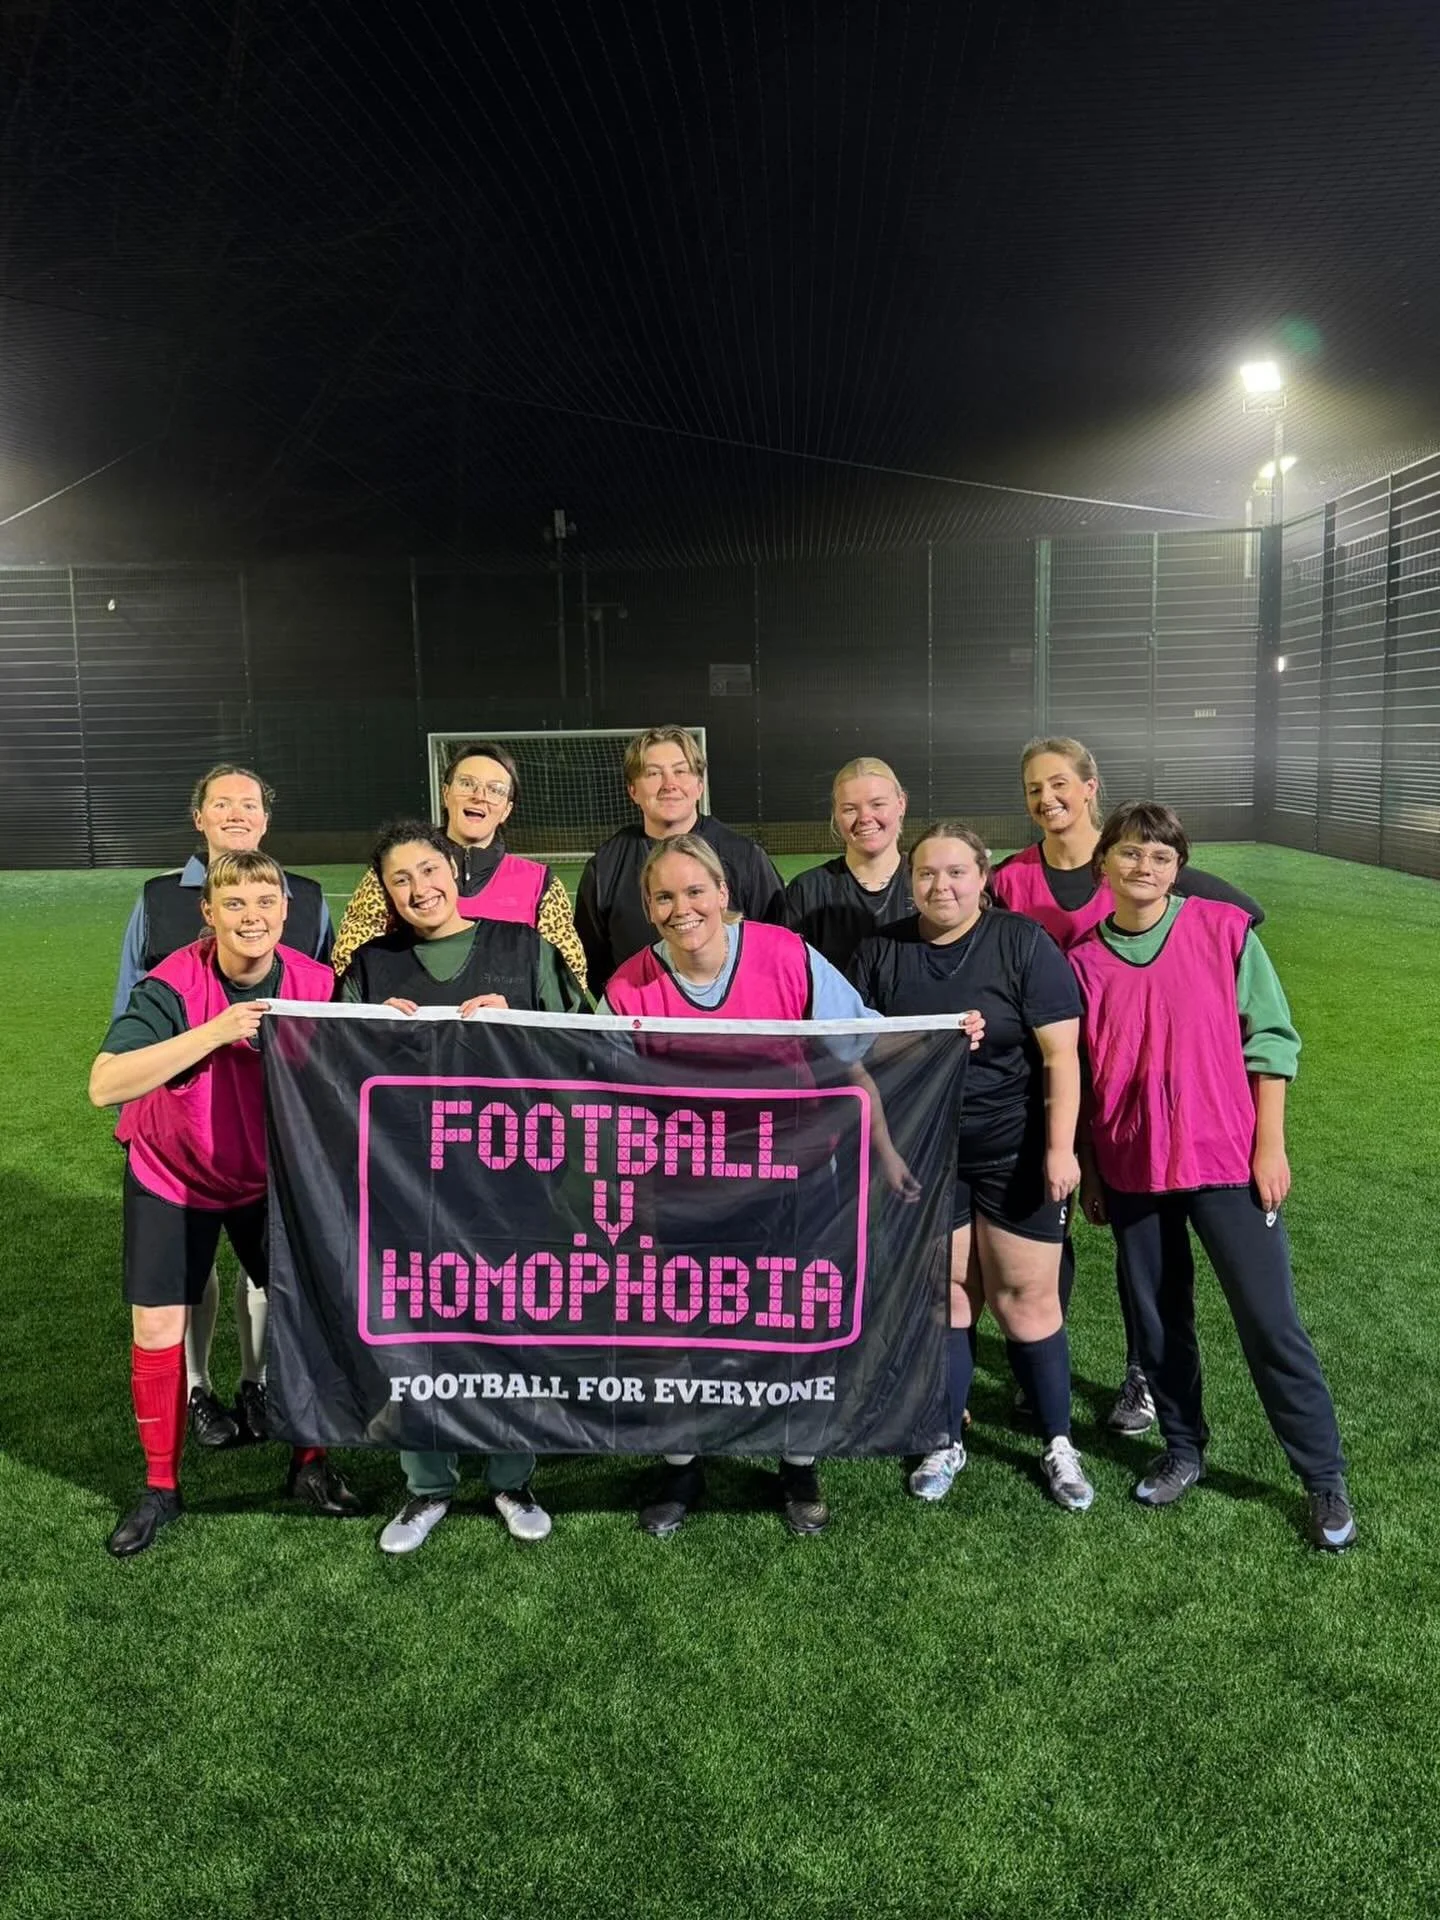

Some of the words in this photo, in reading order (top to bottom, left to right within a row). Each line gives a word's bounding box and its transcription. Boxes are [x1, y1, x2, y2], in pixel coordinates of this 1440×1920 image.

[431, 1100, 798, 1179] FOOTBALL
[382, 1249, 842, 1329] HOMOPHOBIA
[390, 1373, 569, 1402] FOOTBALL
[577, 1376, 646, 1402] FOR
[654, 1376, 836, 1407] EVERYONE
